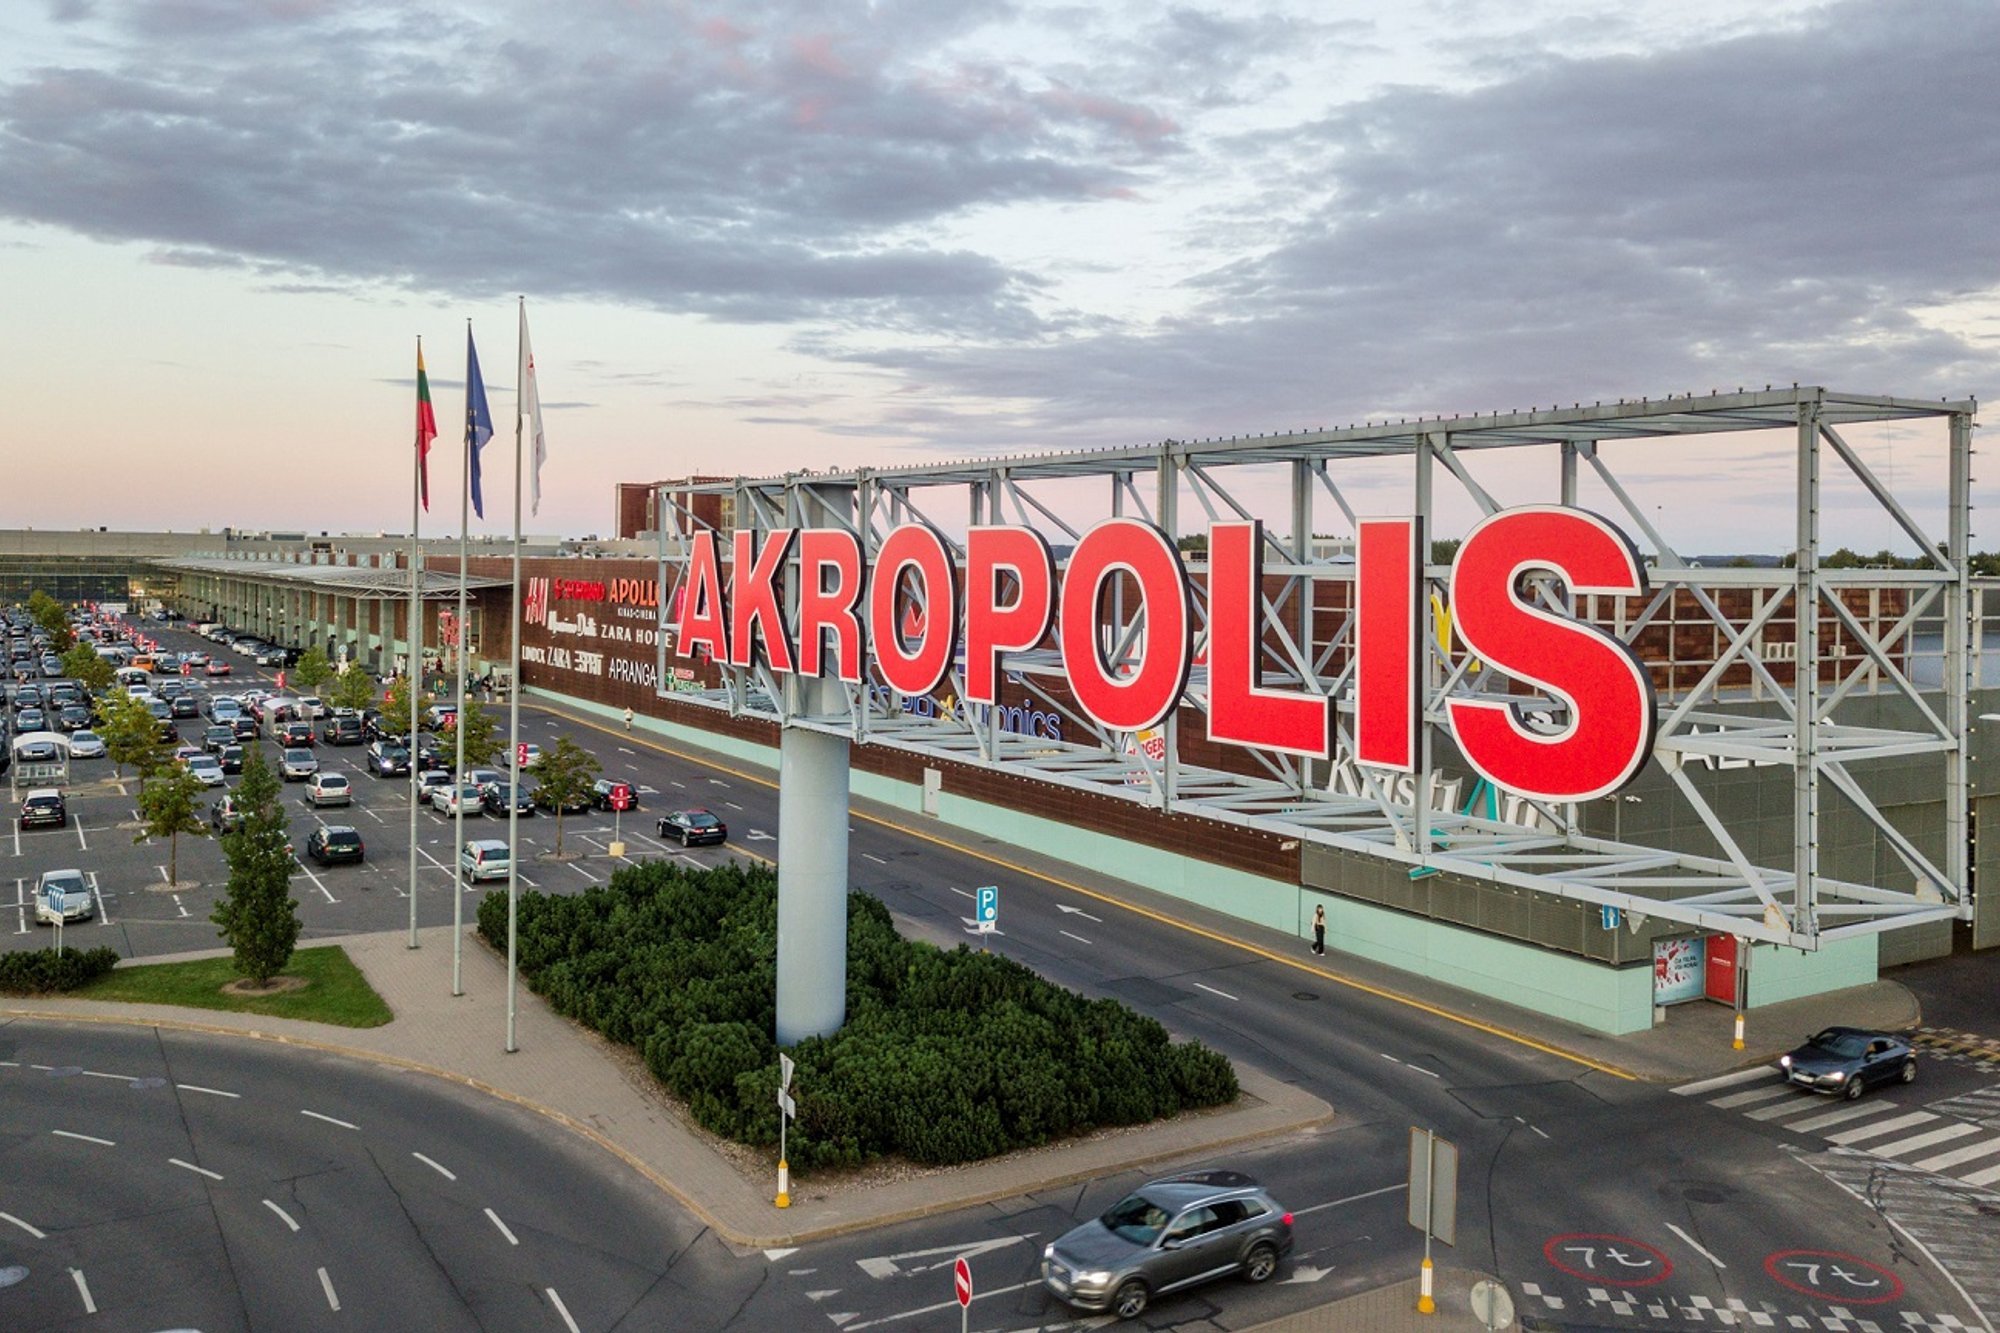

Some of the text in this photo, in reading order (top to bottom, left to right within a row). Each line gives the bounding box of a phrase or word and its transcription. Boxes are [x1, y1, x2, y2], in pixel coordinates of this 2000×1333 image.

[601, 624, 632, 642] ZARA
[547, 646, 571, 669] ZARA
[676, 504, 1656, 803] AKROPOLIS
[608, 657, 658, 689] APRANGA
[982, 890, 994, 909] P
